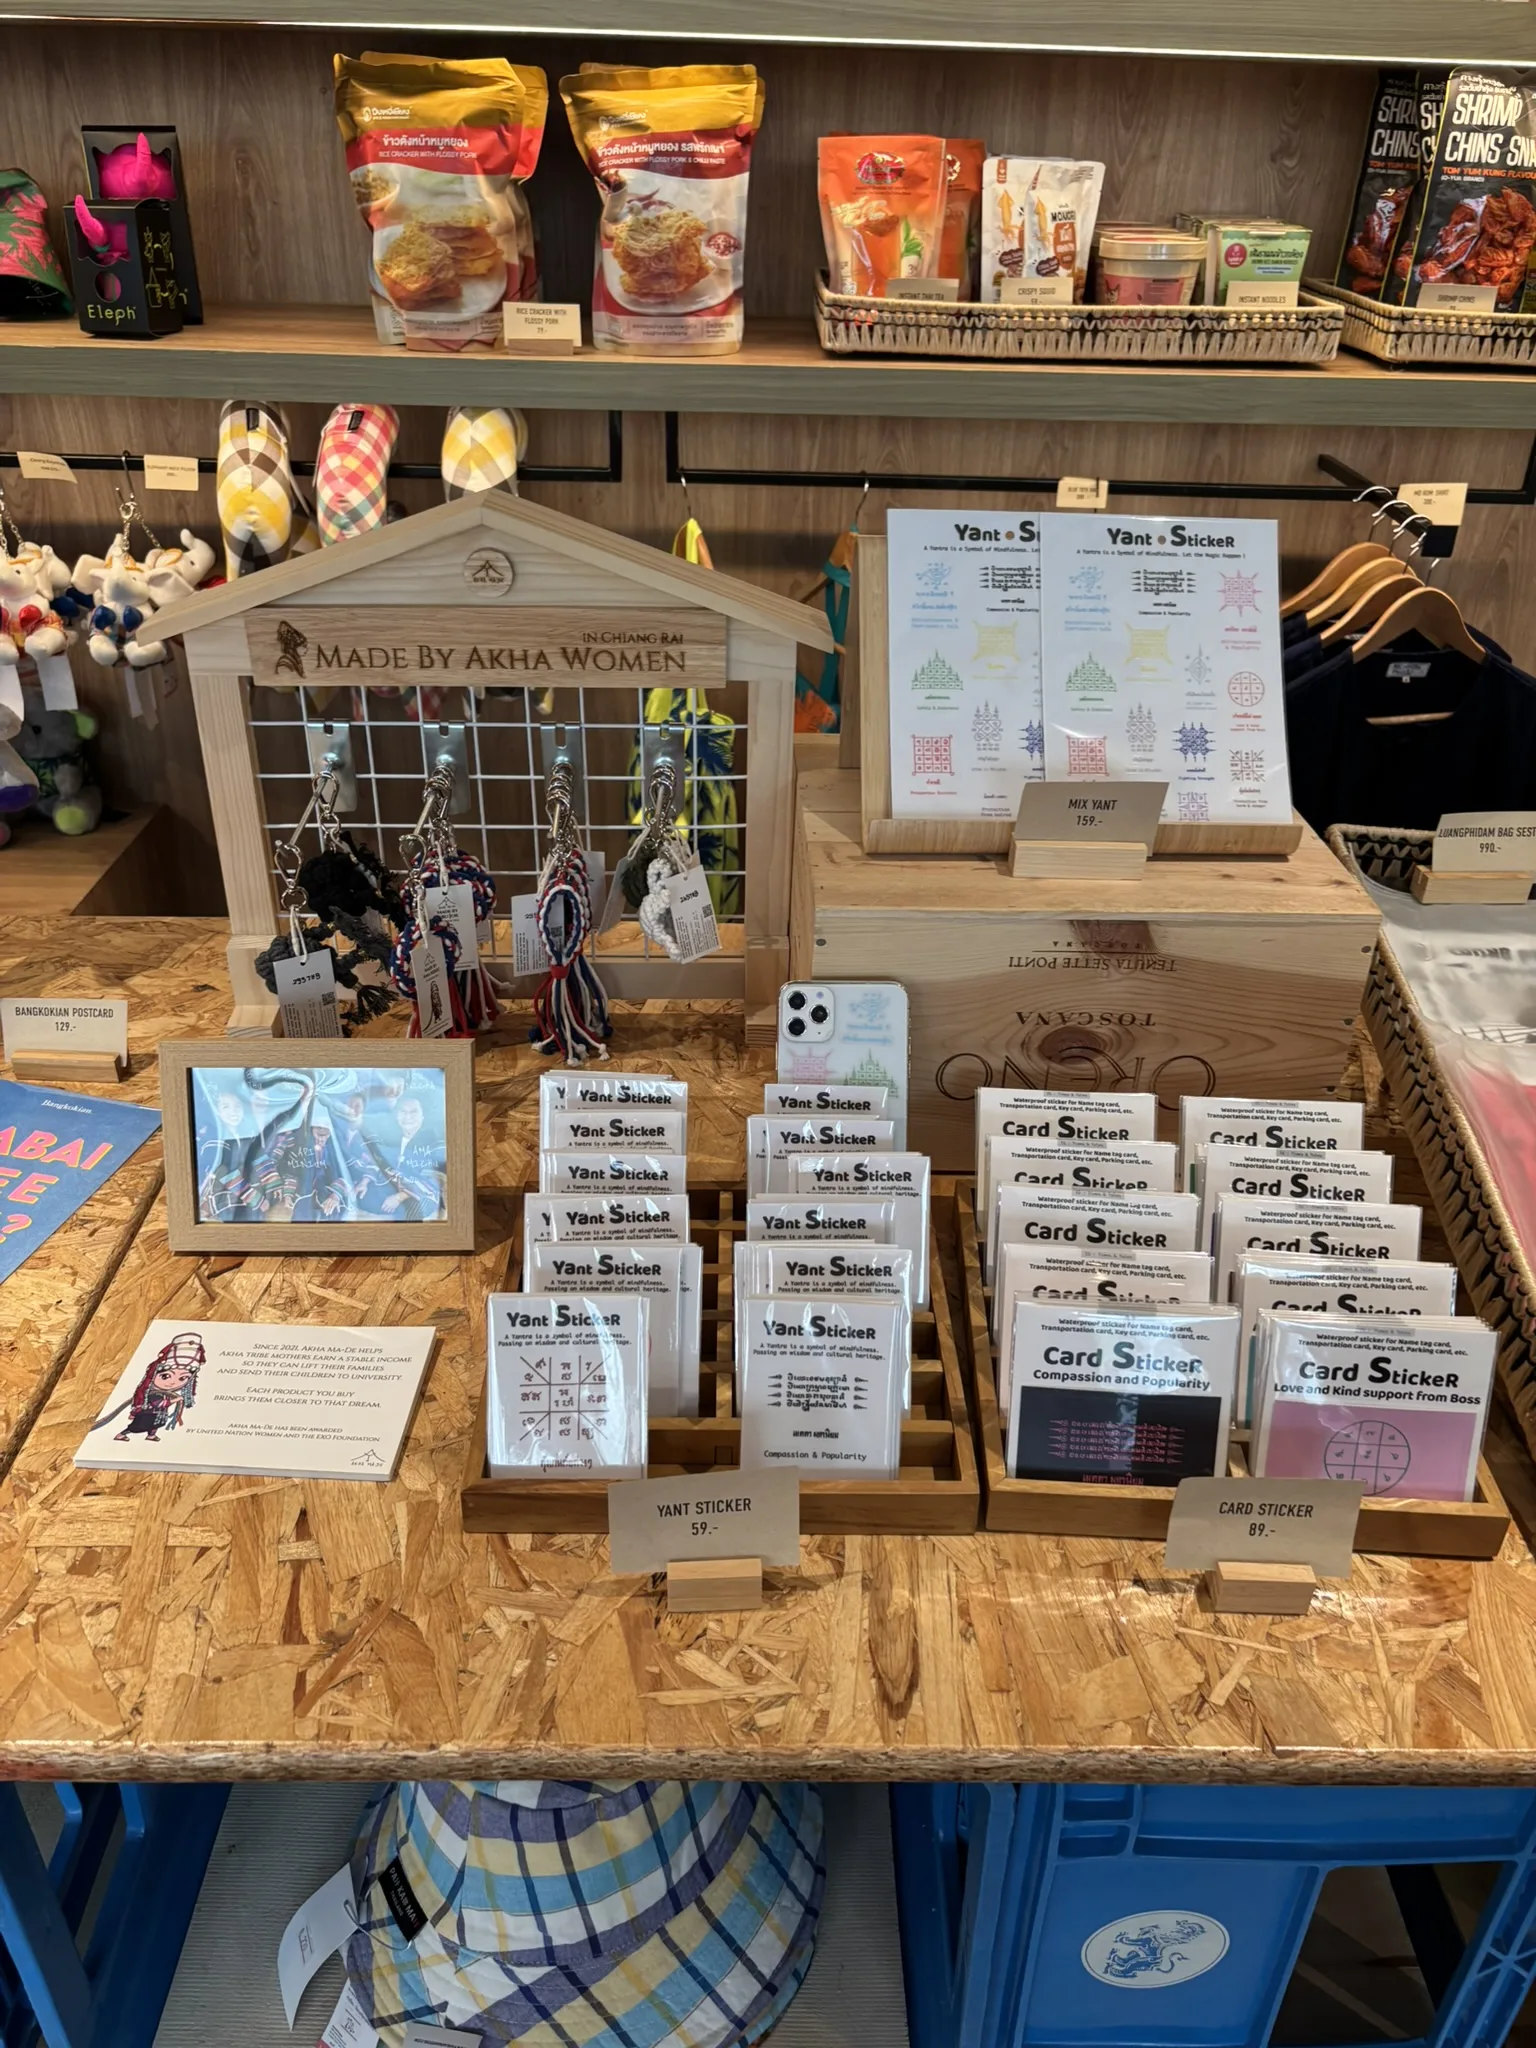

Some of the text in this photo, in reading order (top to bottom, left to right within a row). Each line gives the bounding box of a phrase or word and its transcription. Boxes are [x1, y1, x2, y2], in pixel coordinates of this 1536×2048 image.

[1452, 92, 1523, 127] SHRIMP
[1444, 130, 1504, 164] CHINS
[1238, 295, 1286, 304] INSTANT NOODLES
[87, 304, 136, 326] Eleph
[516, 307, 567, 316] RICE CRACKER WITH
[524, 317, 547, 325] FLOSSY
[1107, 527, 1152, 546] Yant
[582, 631, 684, 645] IN CHIANG RAI
[315, 644, 688, 672] MADE BY AKHA WOMEN
[1068, 799, 1118, 811] MIX YANT
[1076, 815, 1103, 827] 159.-
[1438, 827, 1495, 838] LUANGPHIDAM
[1497, 826, 1514, 838] BAG
[1479, 842, 1502, 854] 990.-
[1008, 956, 1177, 972] TENUTA SETTE PONTI
[14, 1006, 114, 1018] BANGKOKIAN POSTCARD
[1016, 1011, 1156, 1027] TOSCANA
[54, 1022, 77, 1032] 129.-
[778, 1095, 812, 1109] Yant
[570, 1124, 605, 1138] Yant
[1002, 1121, 1049, 1137] Card
[780, 1131, 815, 1144] Yant
[1231, 1177, 1281, 1196] Card
[1024, 1221, 1078, 1241] Card
[553, 1260, 593, 1276] Yant
[786, 1261, 825, 1277] Yant
[507, 1311, 549, 1328] Yant
[763, 1320, 804, 1336] Yant
[219, 1350, 244, 1358] AKHA
[246, 1351, 270, 1359] TRIBE
[270, 1352, 311, 1361] MOTHERS
[253, 1343, 279, 1351] SINCE
[327, 1346, 357, 1354] MA-DE
[1044, 1346, 1102, 1368] Card
[238, 1368, 262, 1376] SEND
[264, 1369, 289, 1377] THEIR
[290, 1370, 336, 1379] CHILDREN
[301, 1362, 319, 1370] LIFT
[347, 1364, 385, 1372] FAMILIES
[1299, 1360, 1359, 1382] Card
[1033, 1369, 1211, 1392] Compassion and Popularity
[246, 1386, 271, 1394] EACH
[272, 1387, 315, 1396] PRODUCT
[1274, 1382, 1481, 1406] Love and Kind support from Boss
[213, 1394, 247, 1402] BRINGS
[274, 1397, 308, 1405] CLOSER
[323, 1399, 348, 1407] THAT
[348, 1400, 382, 1408] DREAM.
[224, 1429, 253, 1437] NATION
[254, 1430, 283, 1438] WOMEN
[249, 1423, 274, 1431] MA-DE
[764, 1450, 867, 1462] Compassion & Popularity
[656, 1497, 752, 1518] YANT STICKER
[1218, 1501, 1314, 1519] CARD STICKER
[691, 1521, 719, 1536] 59.-
[1248, 1522, 1276, 1538] 89.-
